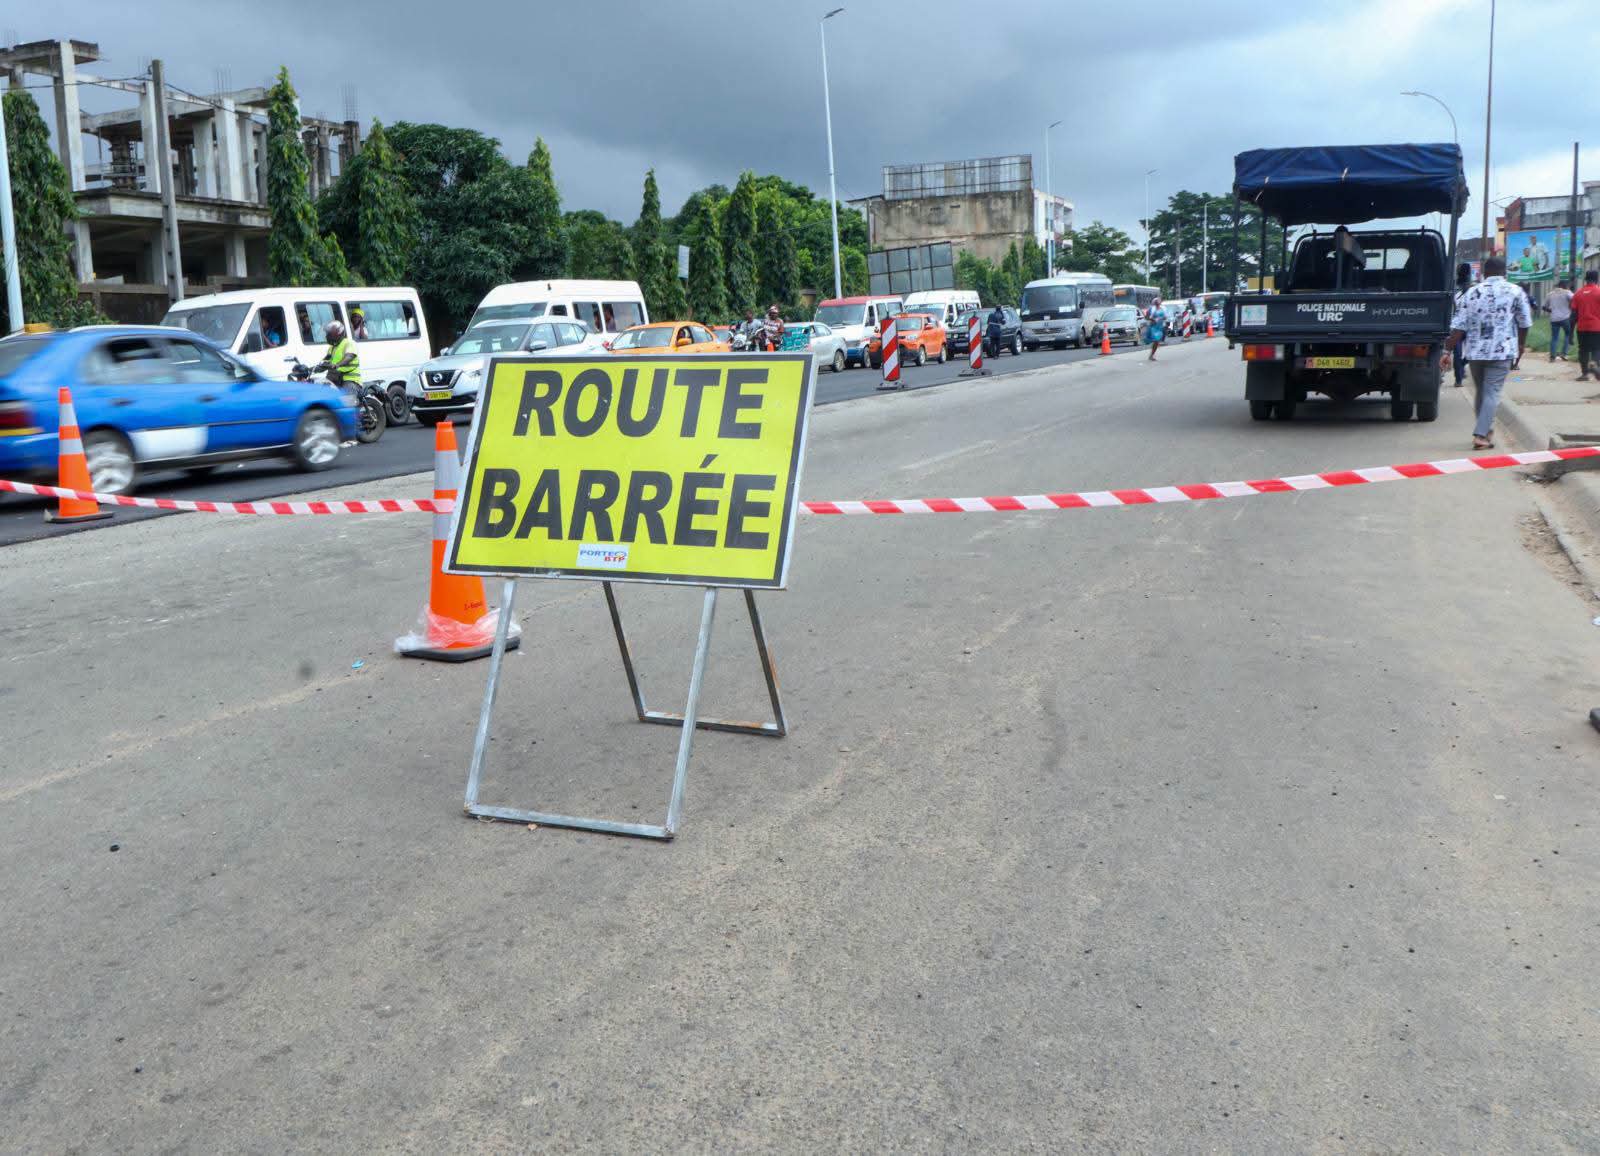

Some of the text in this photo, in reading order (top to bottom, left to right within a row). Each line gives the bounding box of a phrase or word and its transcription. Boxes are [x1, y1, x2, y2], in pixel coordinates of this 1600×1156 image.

[1297, 302, 1366, 312] POLICE NATIONALE
[1372, 307, 1429, 315] HYUNDAI
[1317, 312, 1344, 321] URC
[513, 368, 770, 440] ROUTE
[472, 454, 778, 550] BARRÉE
